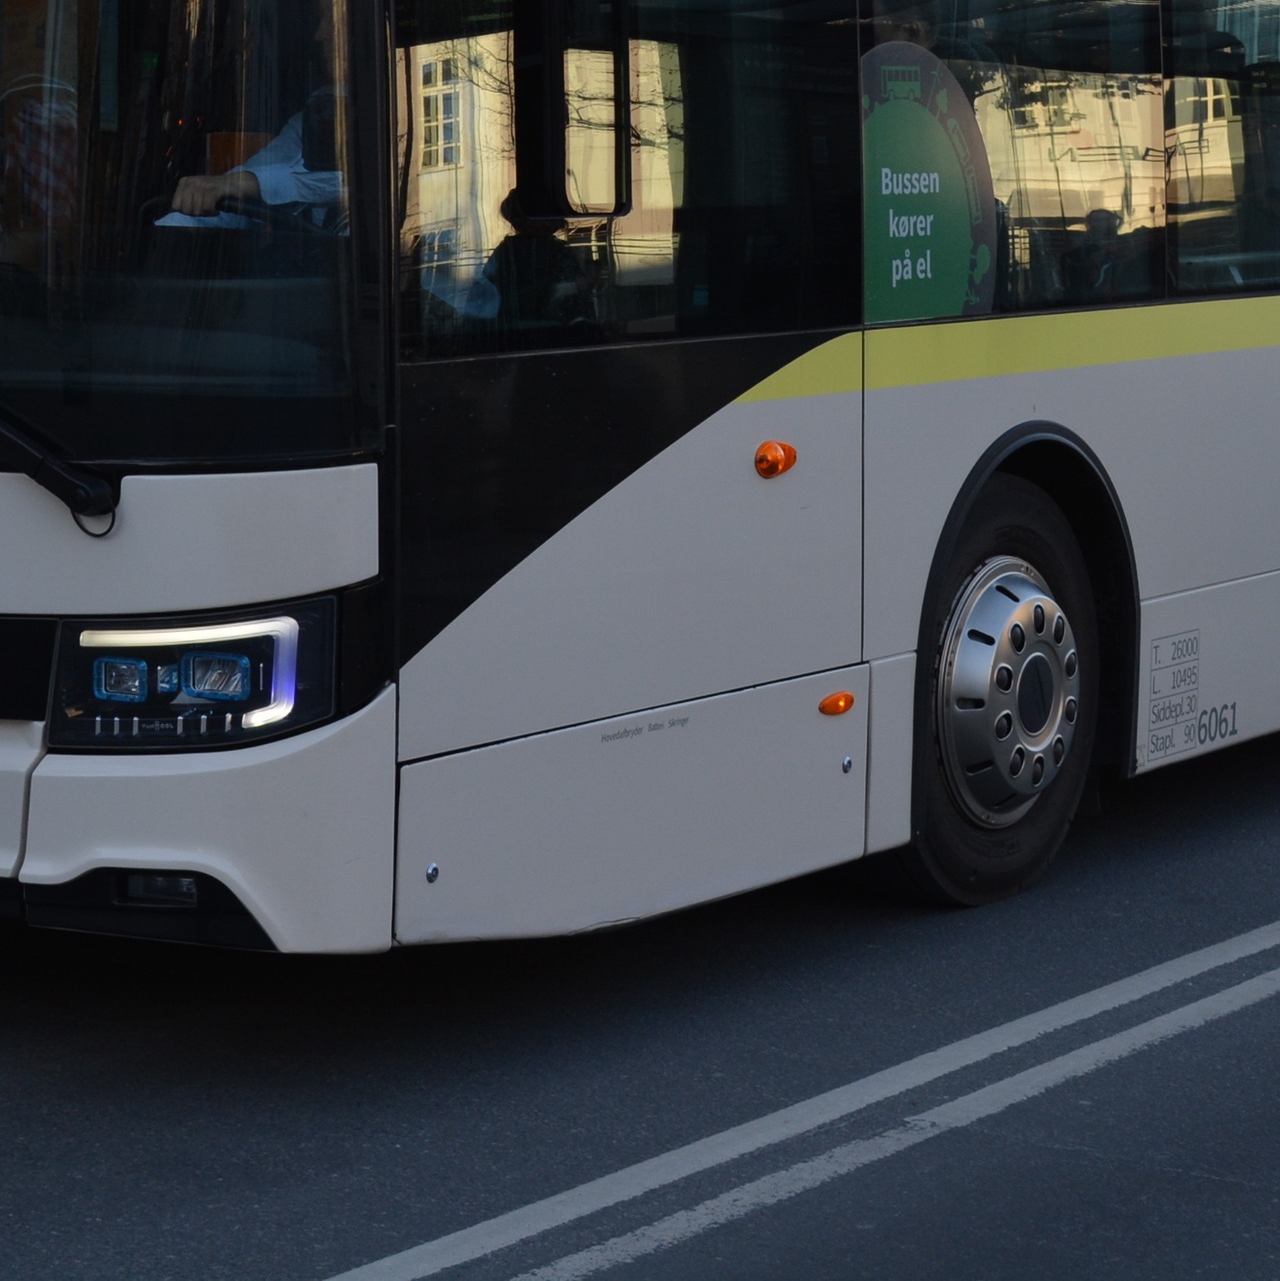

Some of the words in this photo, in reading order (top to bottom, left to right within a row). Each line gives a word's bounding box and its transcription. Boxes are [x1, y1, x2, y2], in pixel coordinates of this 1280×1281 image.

[881, 167, 940, 195] Bussen
[889, 208, 934, 238] kører
[891, 249, 912, 288] på
[916, 249, 932, 279] el
[1171, 636, 1198, 661] 26000
[1171, 665, 1197, 689] 10495
[1186, 694, 1196, 715] 30
[1184, 723, 1195, 744] 90
[1198, 701, 1238, 745] 6061
